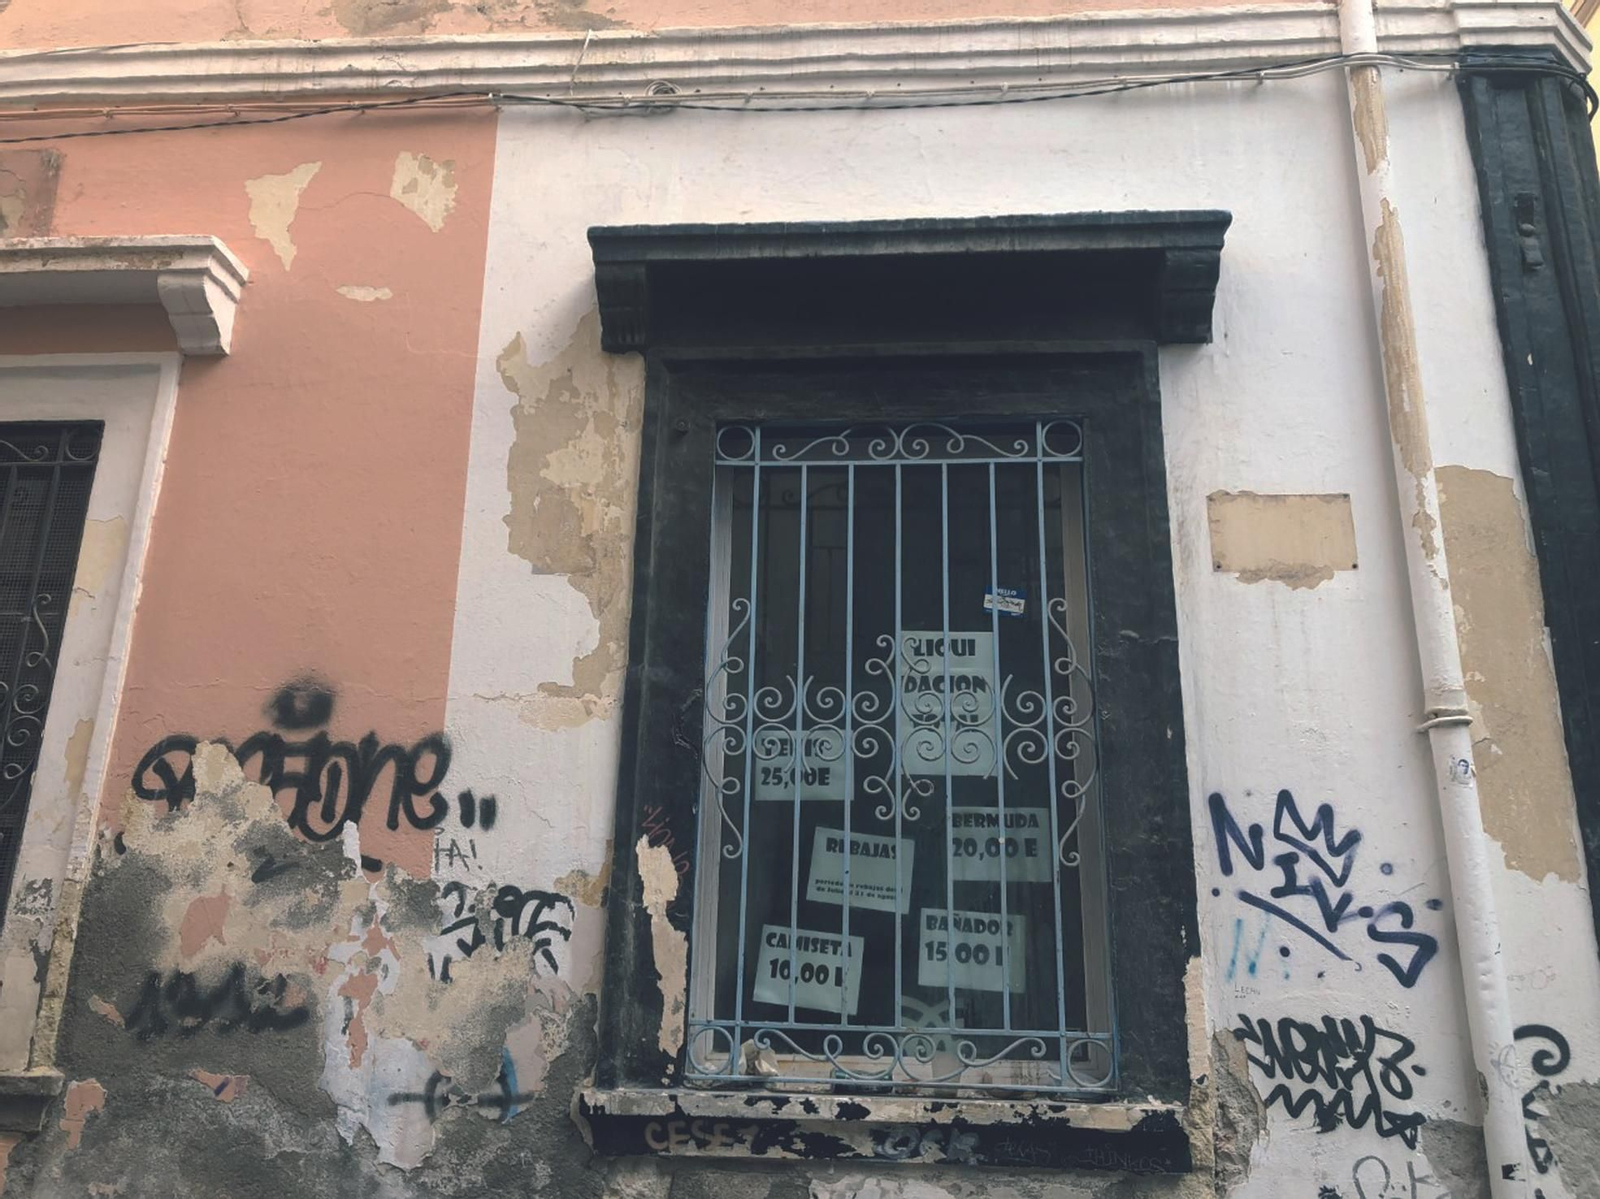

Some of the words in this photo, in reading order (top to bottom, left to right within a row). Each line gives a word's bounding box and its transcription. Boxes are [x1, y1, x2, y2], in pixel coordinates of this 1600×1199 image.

[761, 737, 824, 757] TEIS
[951, 813, 1040, 829] BERMUDA
[951, 836, 1019, 861] 20,00
[1024, 837, 1038, 858] E
[925, 940, 990, 966] 1500
